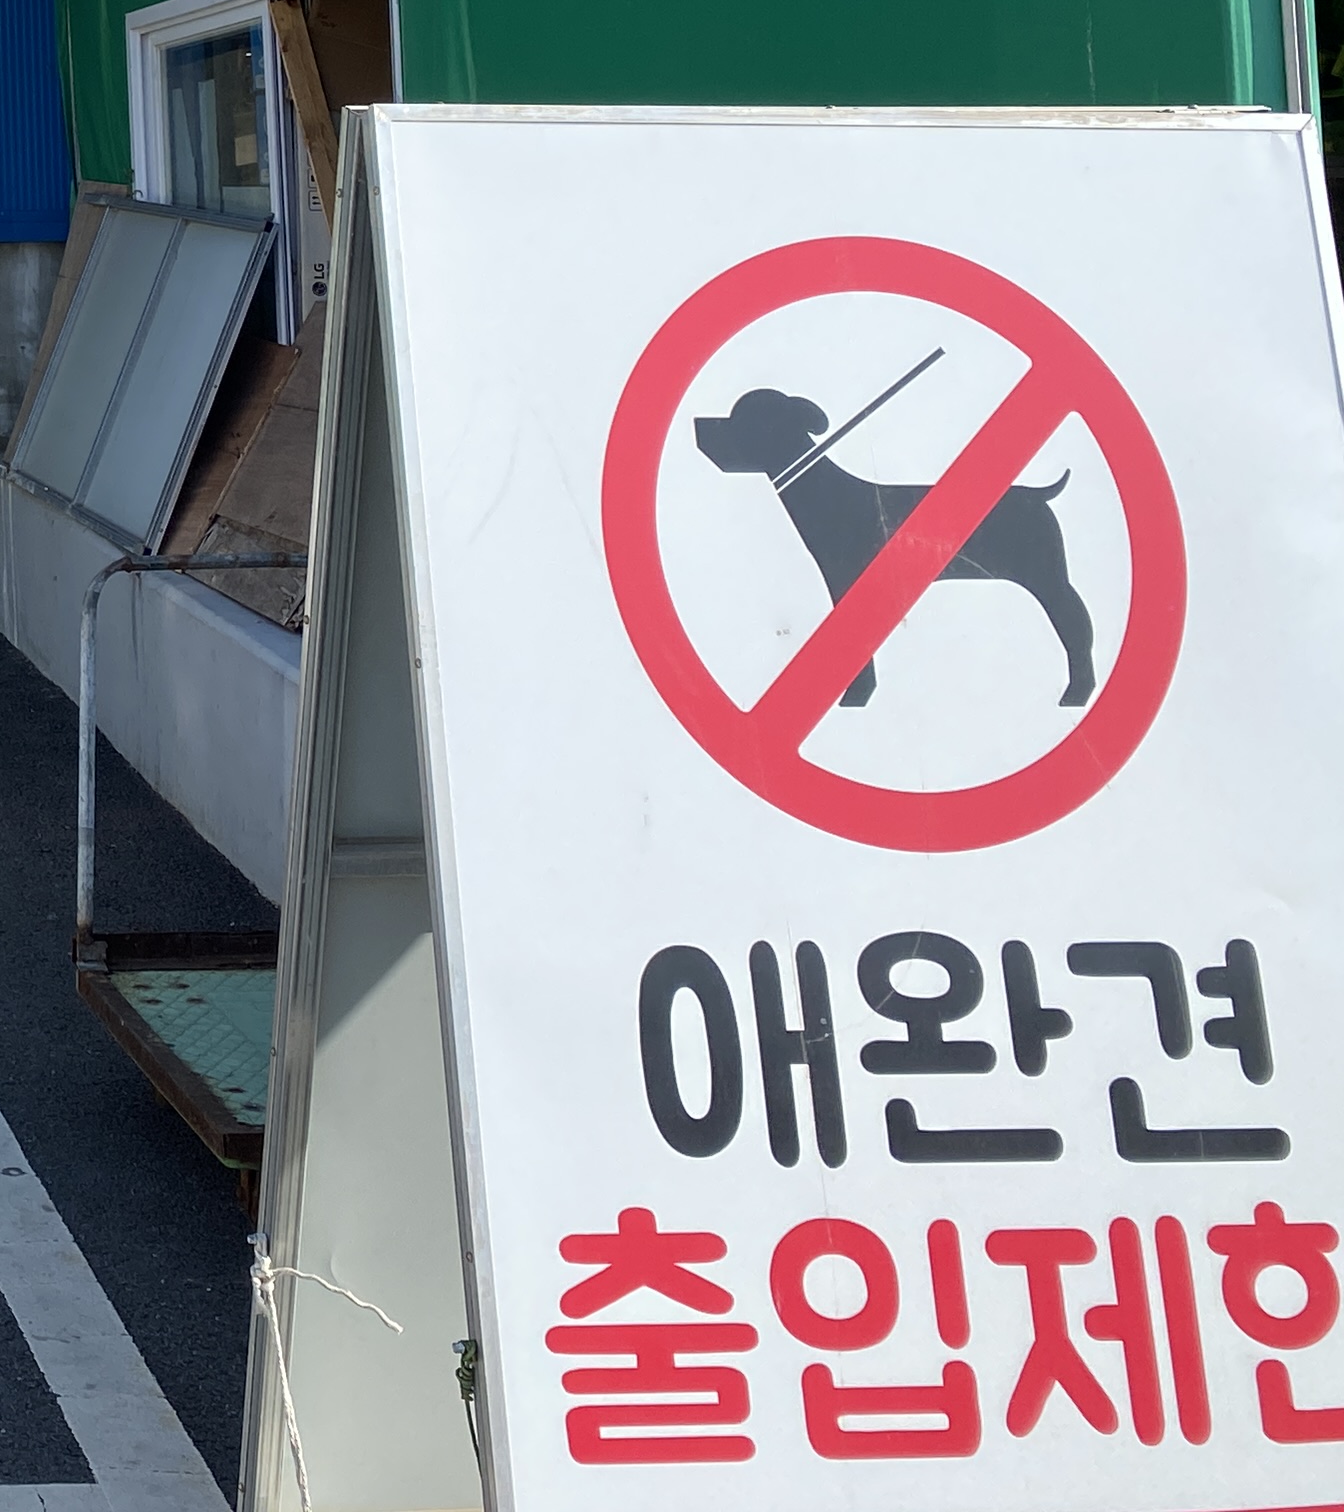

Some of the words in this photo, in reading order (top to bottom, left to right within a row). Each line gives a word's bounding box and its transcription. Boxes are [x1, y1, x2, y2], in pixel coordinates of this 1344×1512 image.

[313, 263, 325, 279] LG
[637, 930, 1291, 1169] 애완견
[544, 1201, 1344, 1466] 출입제한
